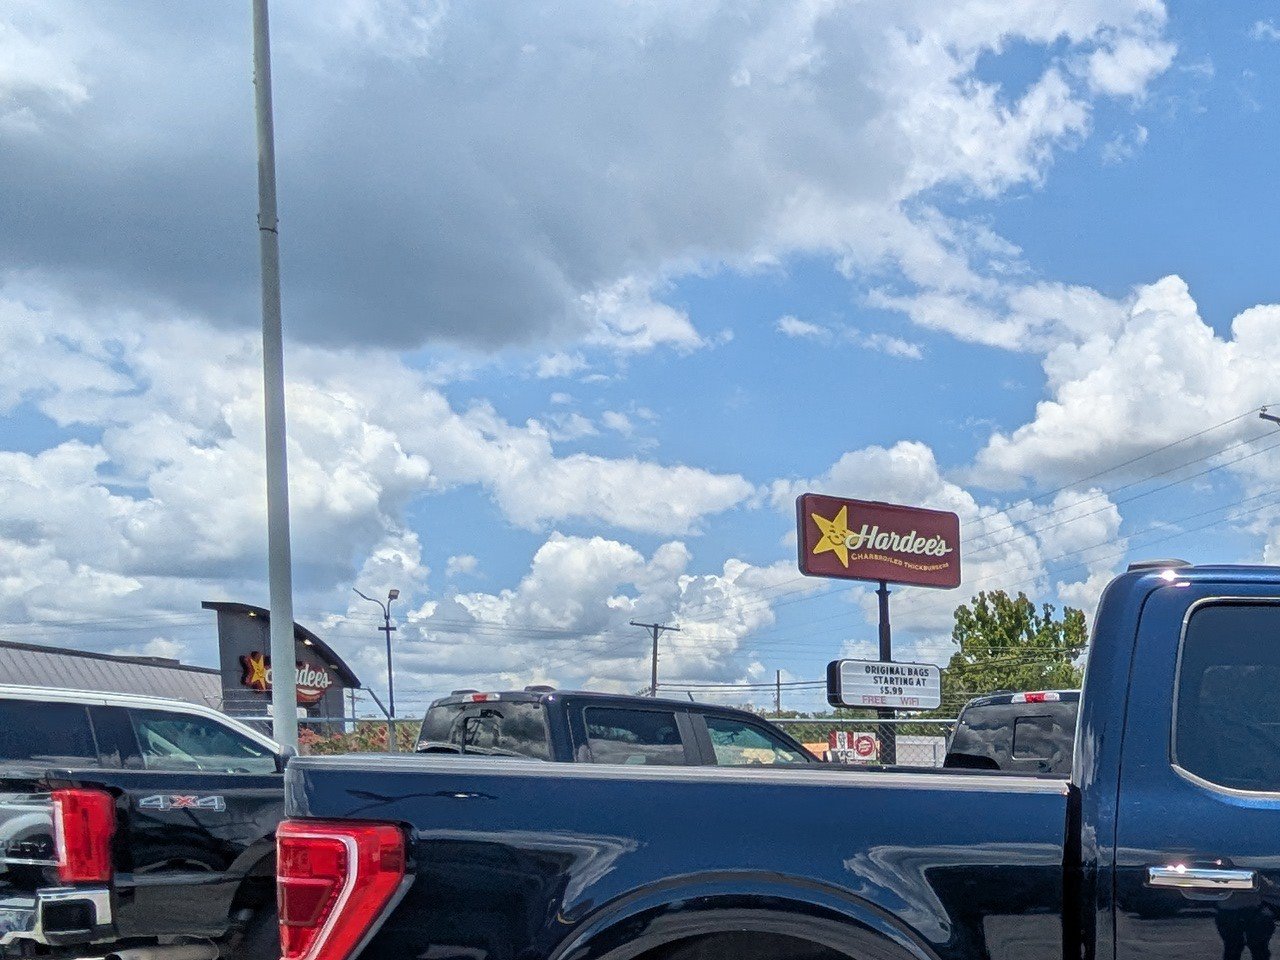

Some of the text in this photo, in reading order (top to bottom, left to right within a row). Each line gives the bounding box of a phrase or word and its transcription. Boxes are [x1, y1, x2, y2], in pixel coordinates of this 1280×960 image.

[844, 524, 953, 557] Hardee's
[851, 553, 903, 566] CHARBROILED
[265, 663, 333, 689] rdee's
[865, 665, 929, 677] ORIGINAL BAGS
[873, 675, 926, 687] STARTING AT
[880, 686, 903, 695] $5.99
[861, 695, 887, 705] FREE
